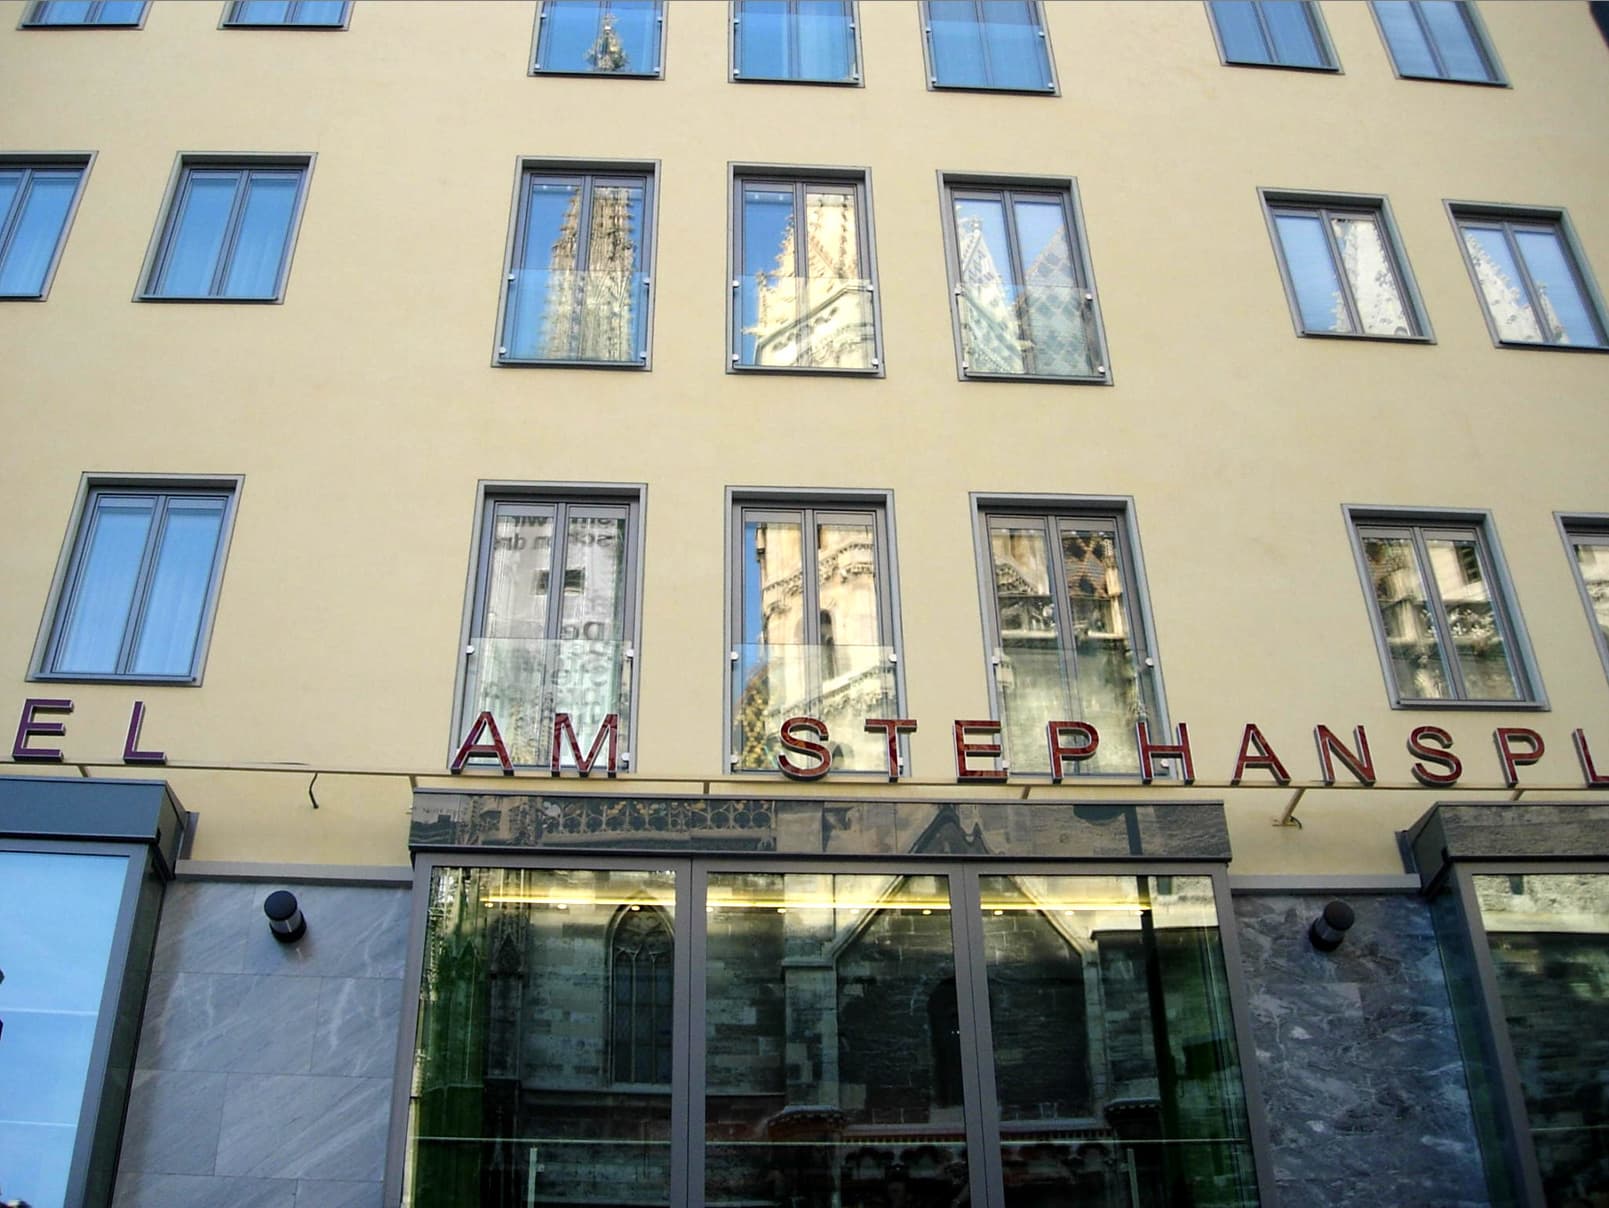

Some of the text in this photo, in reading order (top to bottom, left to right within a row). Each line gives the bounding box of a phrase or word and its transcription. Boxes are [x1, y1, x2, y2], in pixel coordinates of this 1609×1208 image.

[12, 698, 1609, 789] EL AM STEPHANSPL
